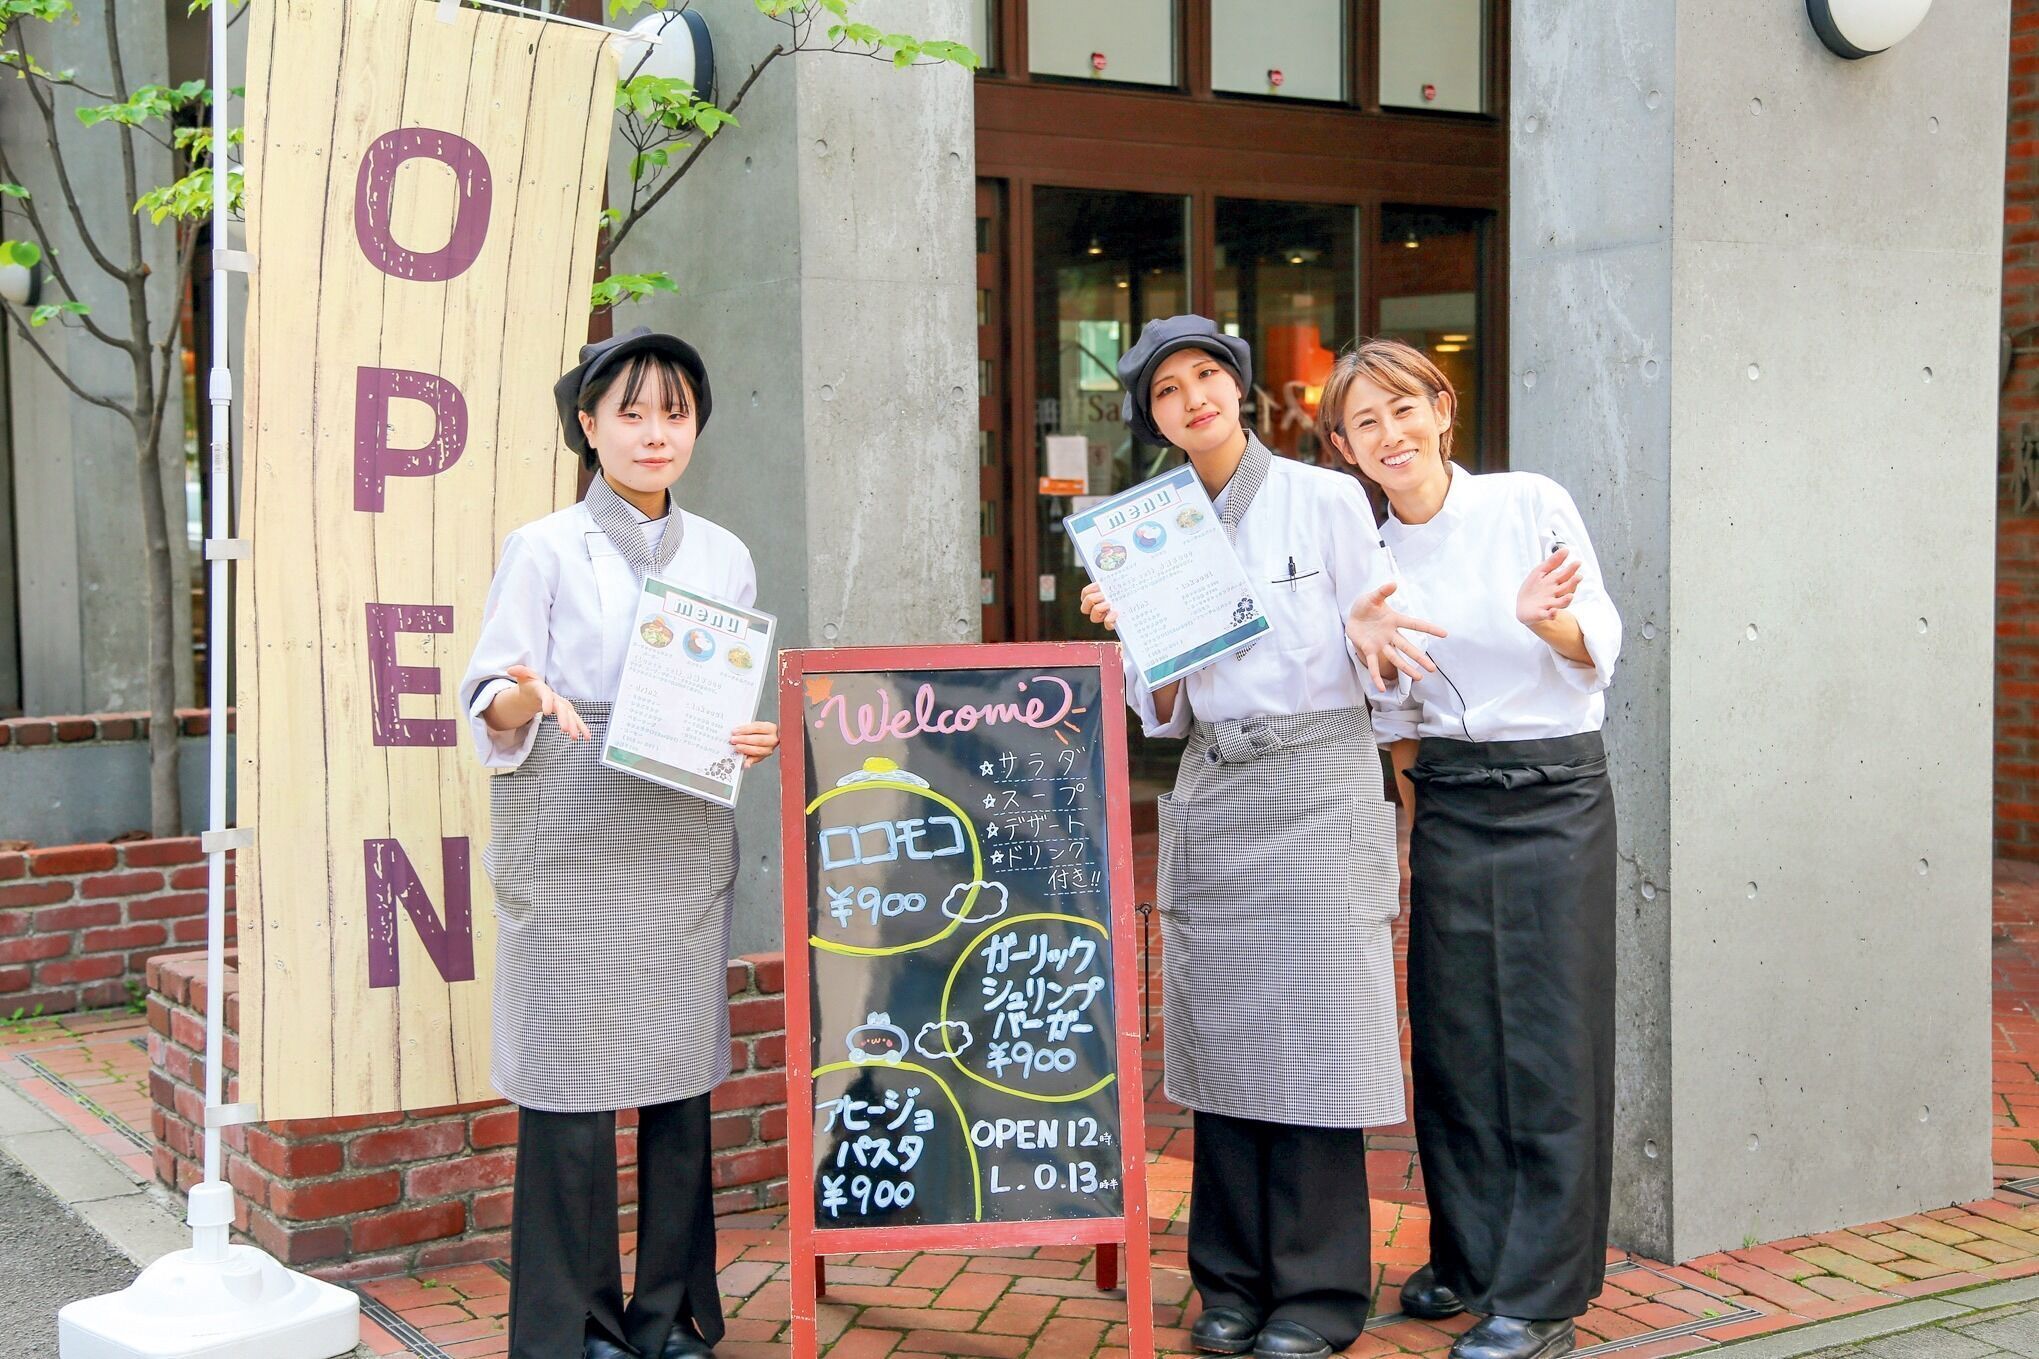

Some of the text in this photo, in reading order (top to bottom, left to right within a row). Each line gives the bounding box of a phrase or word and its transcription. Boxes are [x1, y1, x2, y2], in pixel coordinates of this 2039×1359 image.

[1108, 490, 1172, 530] menu
[354, 128, 492, 988] OPEN
[673, 599, 740, 633] menu
[815, 676, 1073, 745] Welcome
[999, 747, 1086, 778] サラダ
[1002, 783, 1086, 808] スープ
[819, 815, 966, 871] ロコモコ
[1003, 814, 1086, 841] デザート
[1007, 842, 1084, 868] ドリンク
[826, 886, 927, 929] ¥900
[981, 932, 1097, 975] ガーリック
[981, 976, 1105, 1014] シュリンプ
[986, 1041, 1077, 1080] ¥900
[815, 1087, 936, 1133] アヒージョ
[970, 1118, 1059, 1149] OPEN
[837, 1135, 924, 1172] パスタ
[822, 1174, 916, 1217] ¥900
